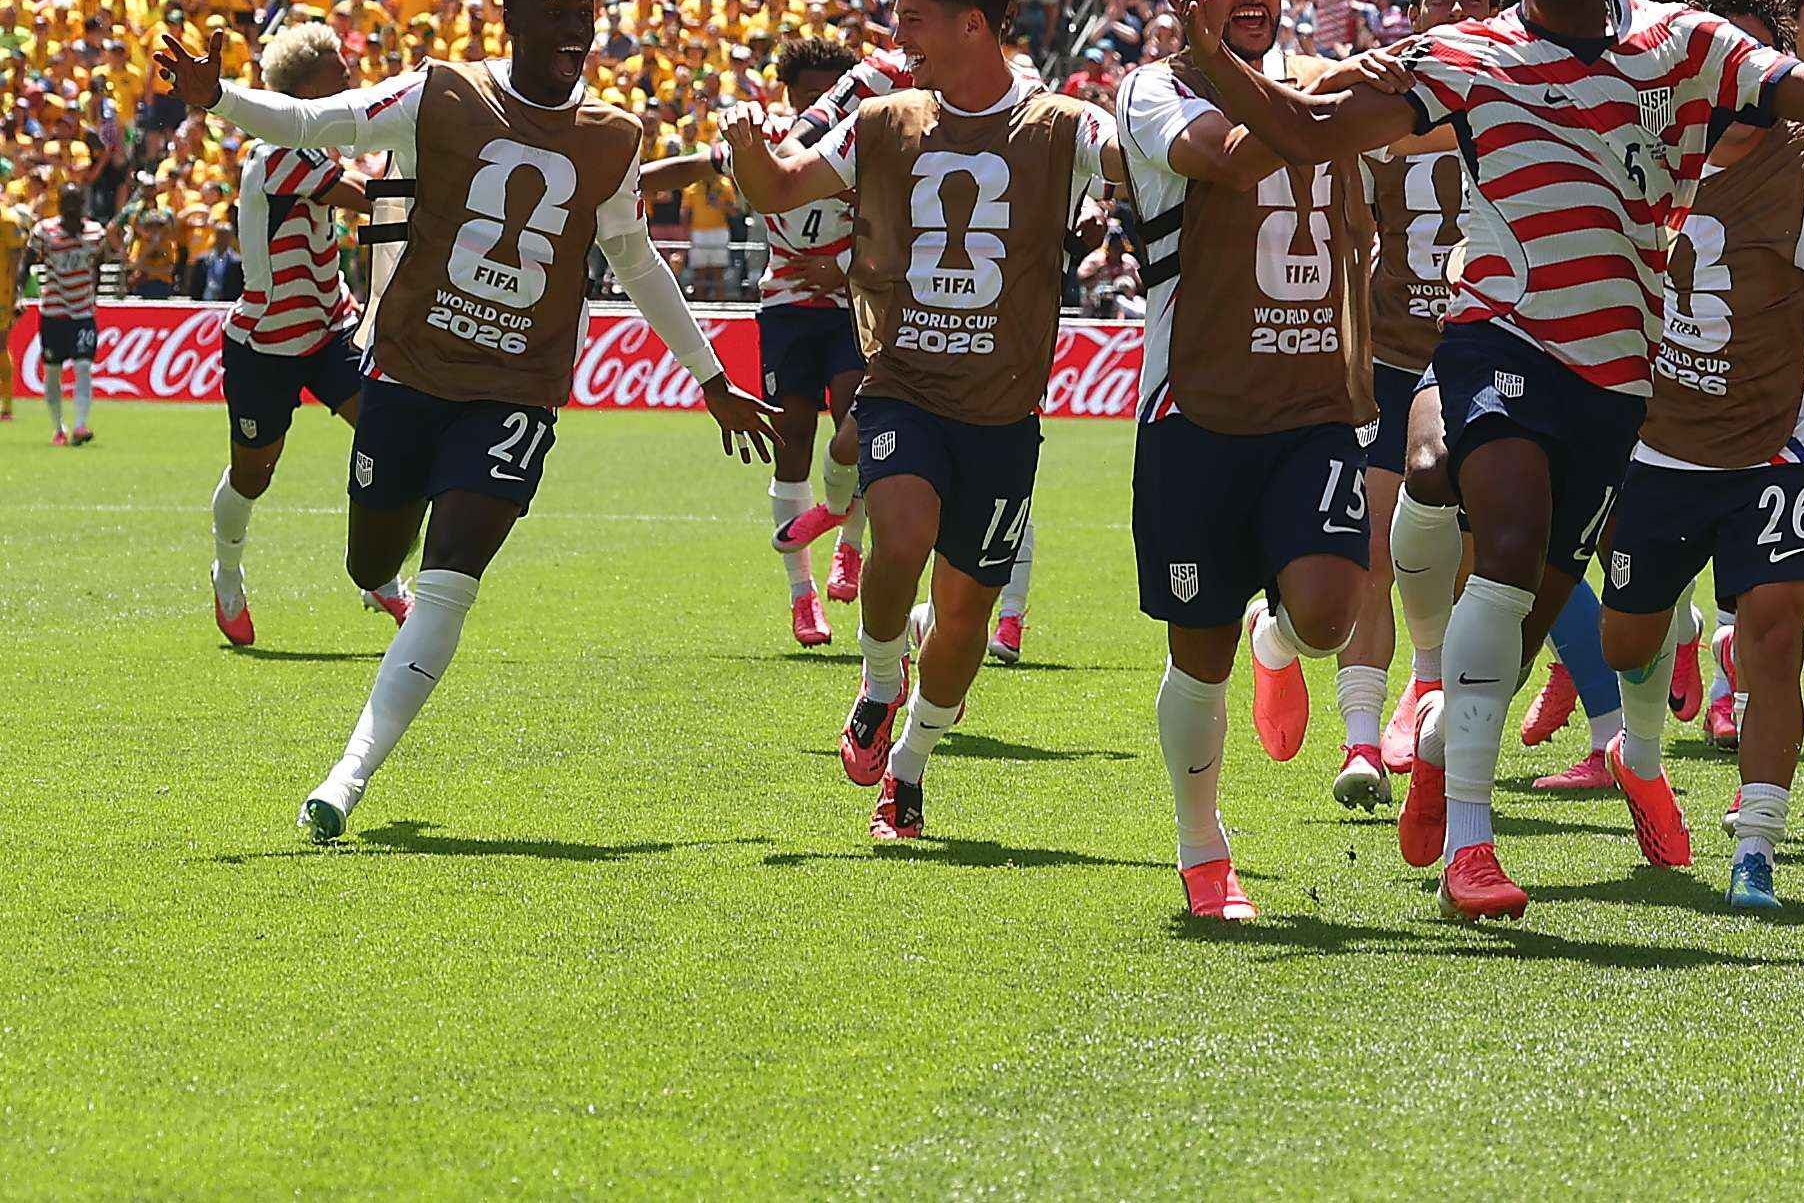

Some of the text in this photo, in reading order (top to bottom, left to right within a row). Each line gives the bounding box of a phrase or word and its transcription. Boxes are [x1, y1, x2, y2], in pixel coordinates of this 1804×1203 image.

[1640, 88, 1668, 110] USA
[801, 209, 822, 244] 4
[473, 265, 519, 293] FIFA
[932, 276, 976, 294] FIFA
[1285, 265, 1320, 284] FIFA
[436, 289, 533, 331] WORLD CUP
[902, 308, 998, 330] WORLD CUP
[1254, 307, 1334, 325] WORLD CUP
[1409, 298, 1451, 317] 20
[426, 306, 528, 355] 2026
[895, 326, 995, 354] 2026
[1251, 327, 1339, 355] 2026
[1658, 343, 1731, 374] ORLD CUP
[1654, 356, 1728, 397] 026
[487, 411, 547, 470] 21
[1318, 459, 1366, 520] 15
[981, 498, 1030, 551] 14
[1172, 565, 1197, 579] USA
